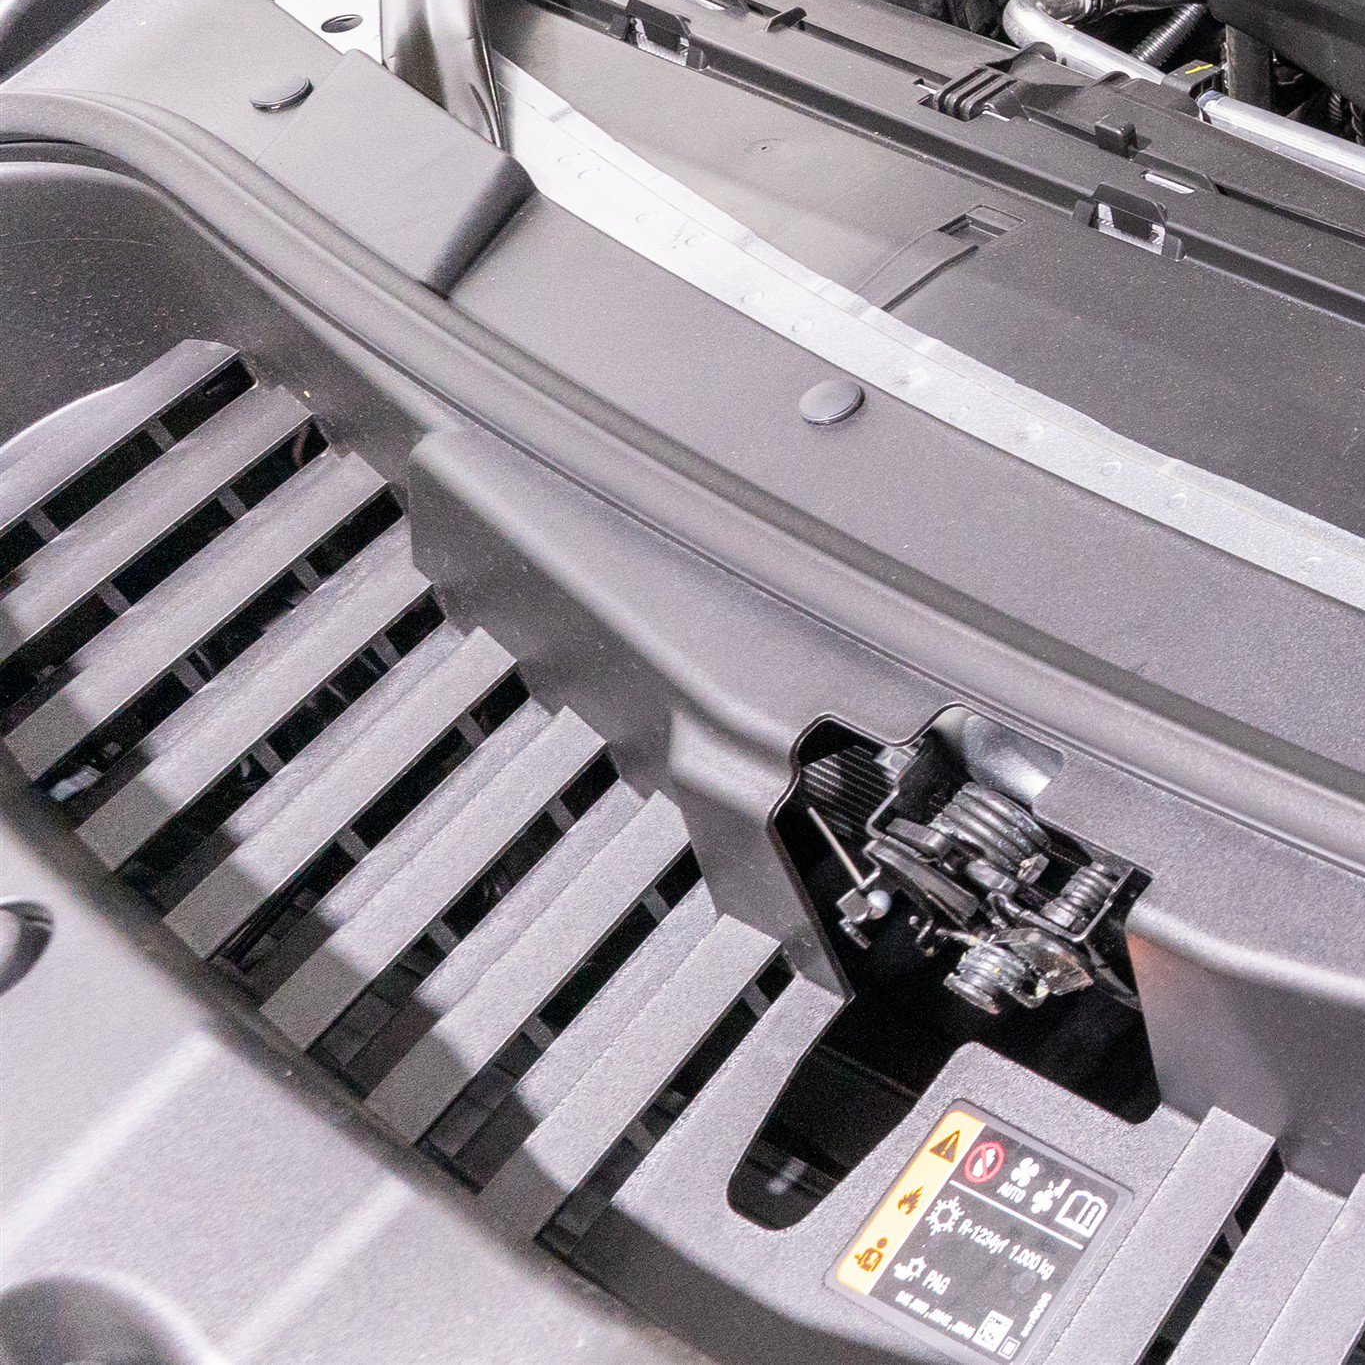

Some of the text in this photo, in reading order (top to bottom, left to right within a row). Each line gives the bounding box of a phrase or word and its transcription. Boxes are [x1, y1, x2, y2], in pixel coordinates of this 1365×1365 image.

[997, 1181, 1027, 1203] AUTO
[957, 1218, 1056, 1281] R-1234yf 1.000 kg
[922, 1270, 951, 1295] PAG
